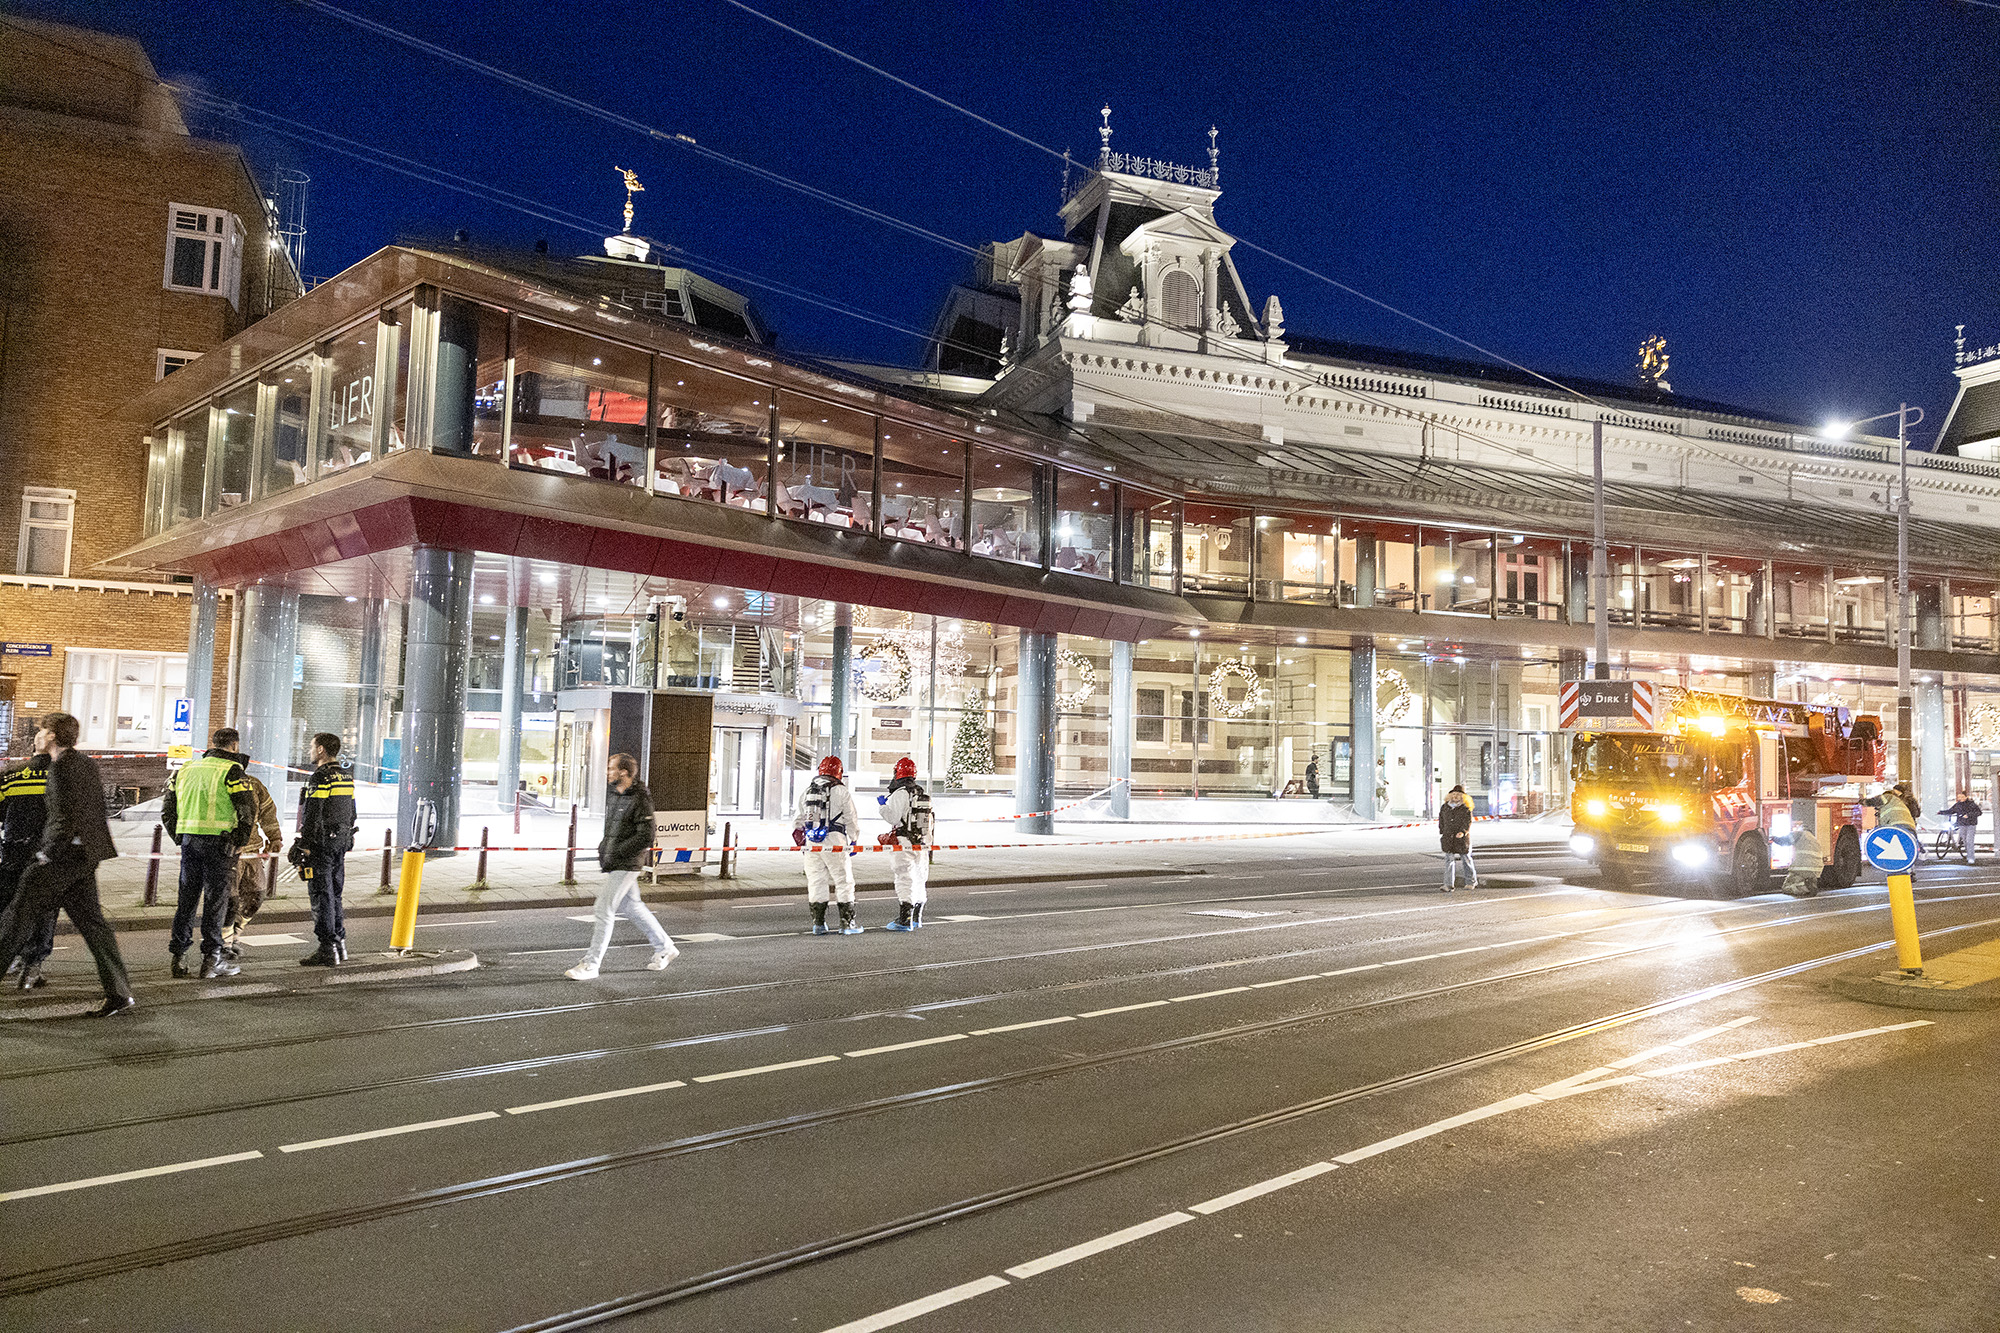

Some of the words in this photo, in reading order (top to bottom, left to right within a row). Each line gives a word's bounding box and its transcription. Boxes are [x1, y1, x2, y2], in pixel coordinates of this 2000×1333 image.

[331, 376, 372, 429] LIER
[792, 440, 857, 491] LIER
[177, 701, 189, 718] P
